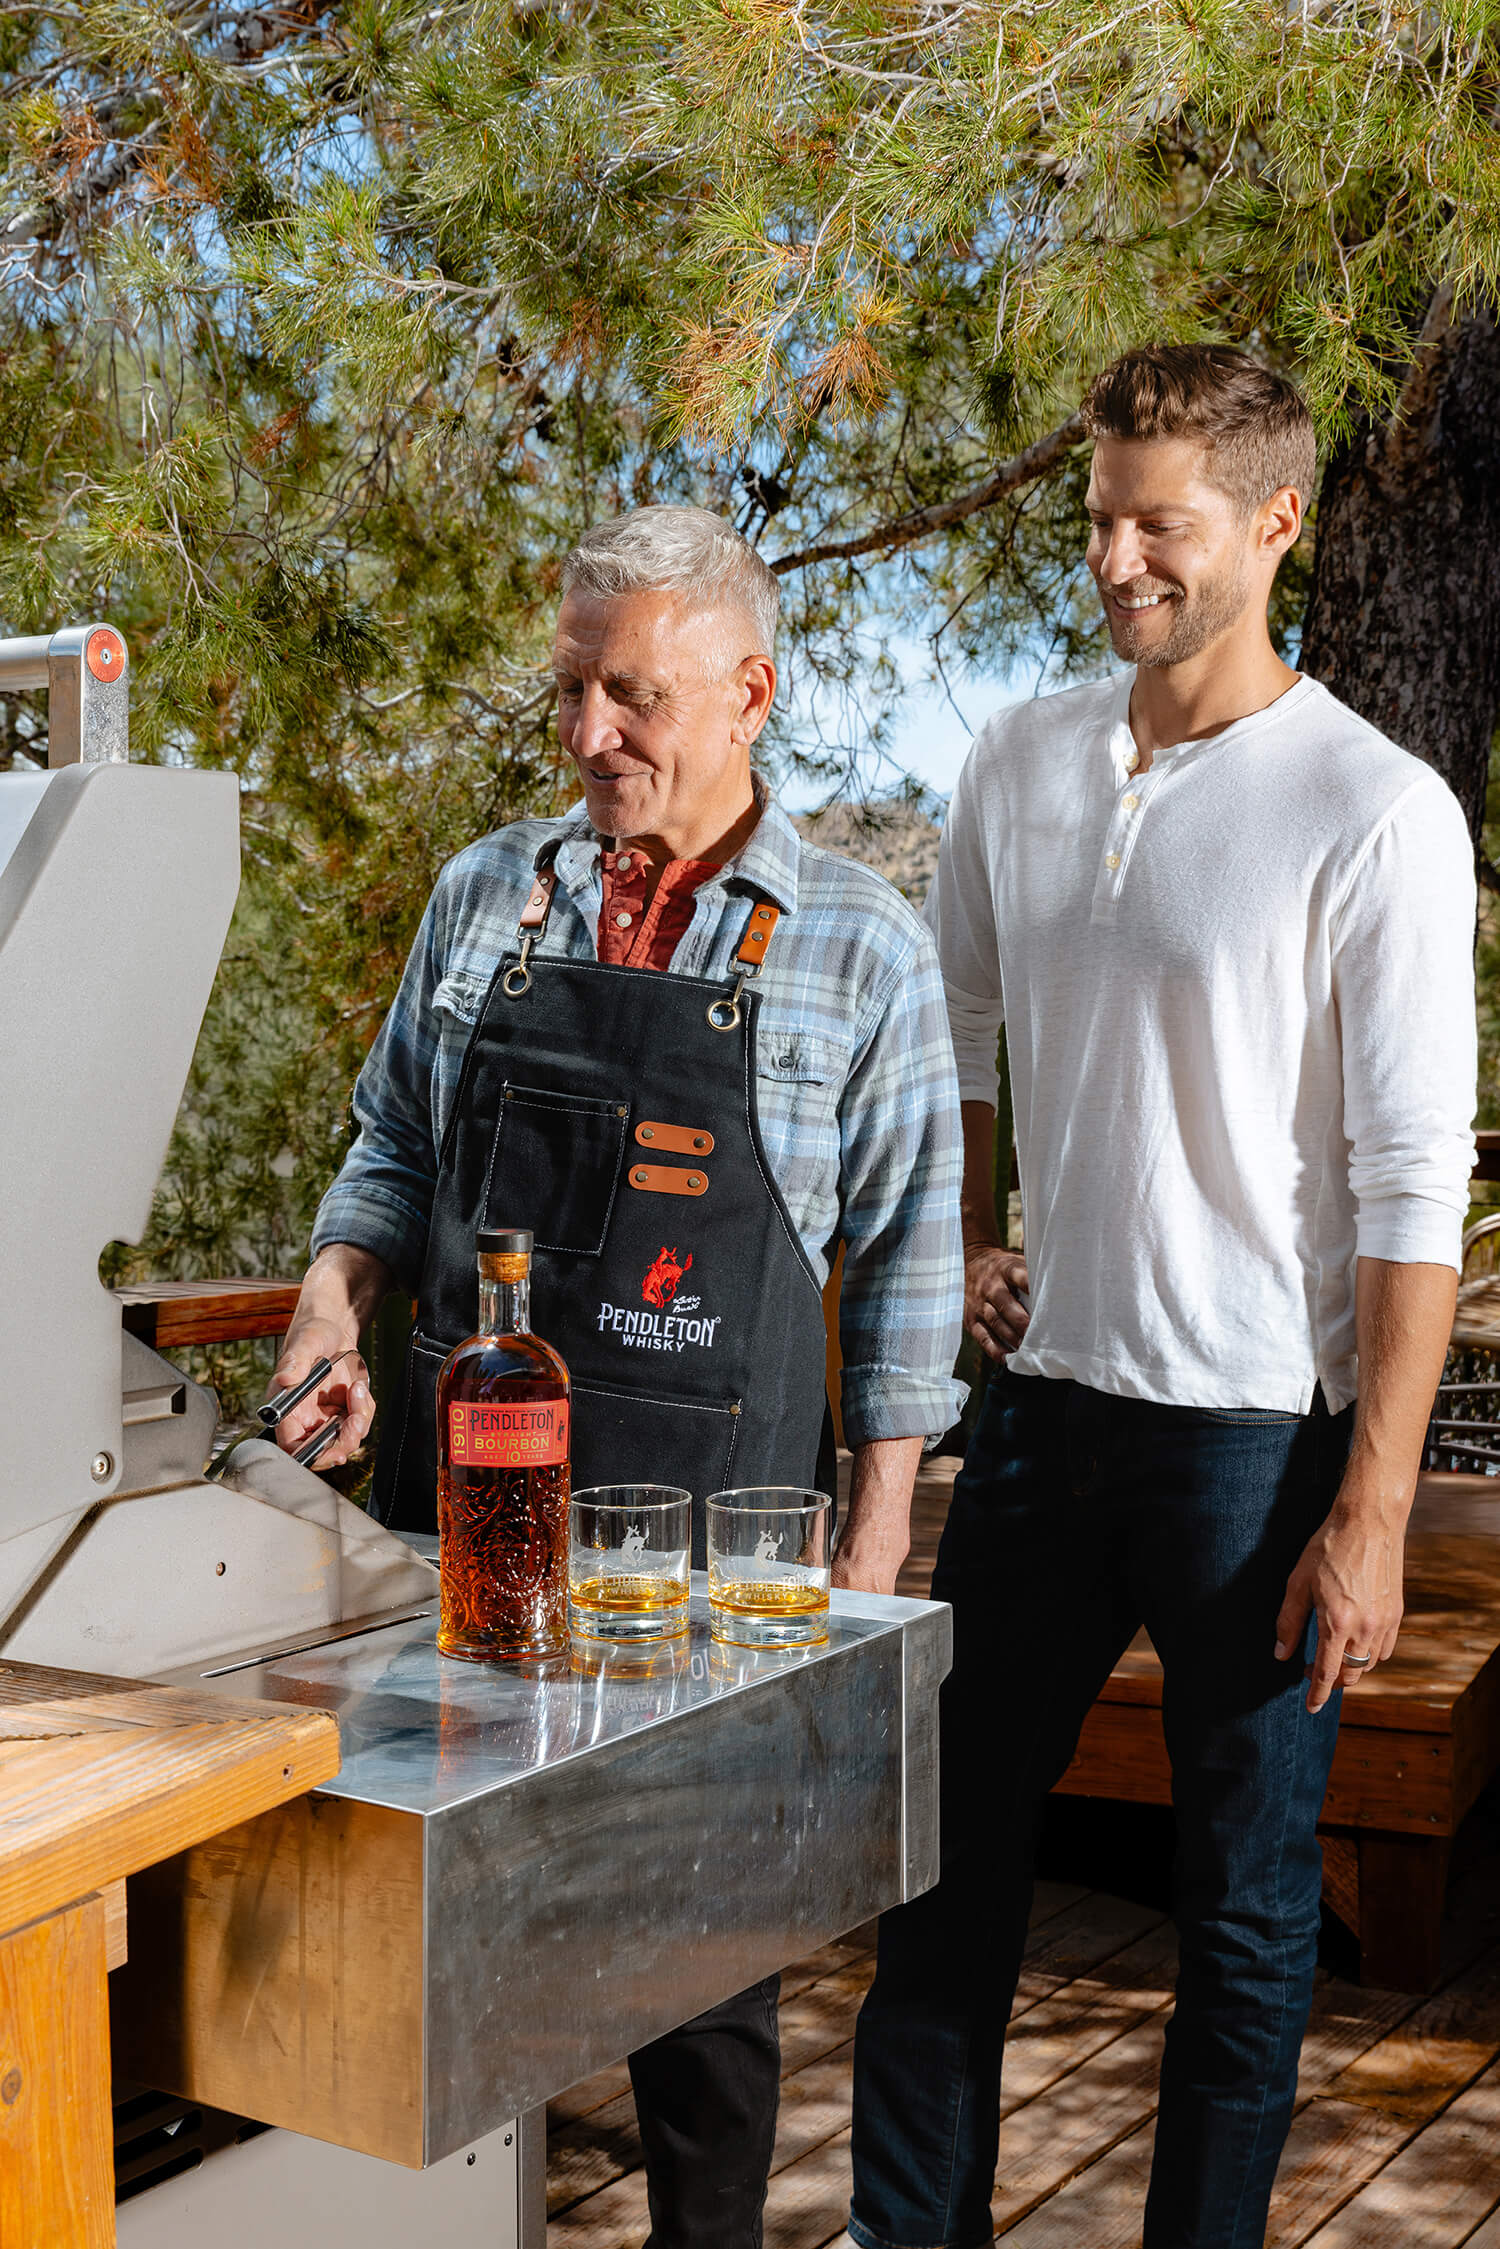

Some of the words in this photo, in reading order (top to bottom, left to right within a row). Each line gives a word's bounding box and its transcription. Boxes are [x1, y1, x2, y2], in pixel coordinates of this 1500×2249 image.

[622, 1334, 685, 1353] WHISKY
[471, 1408, 554, 1431] PENDLETON
[453, 1408, 465, 1456] 1910
[475, 1437, 550, 1449] BOURBON
[506, 1451, 520, 1462] 10
